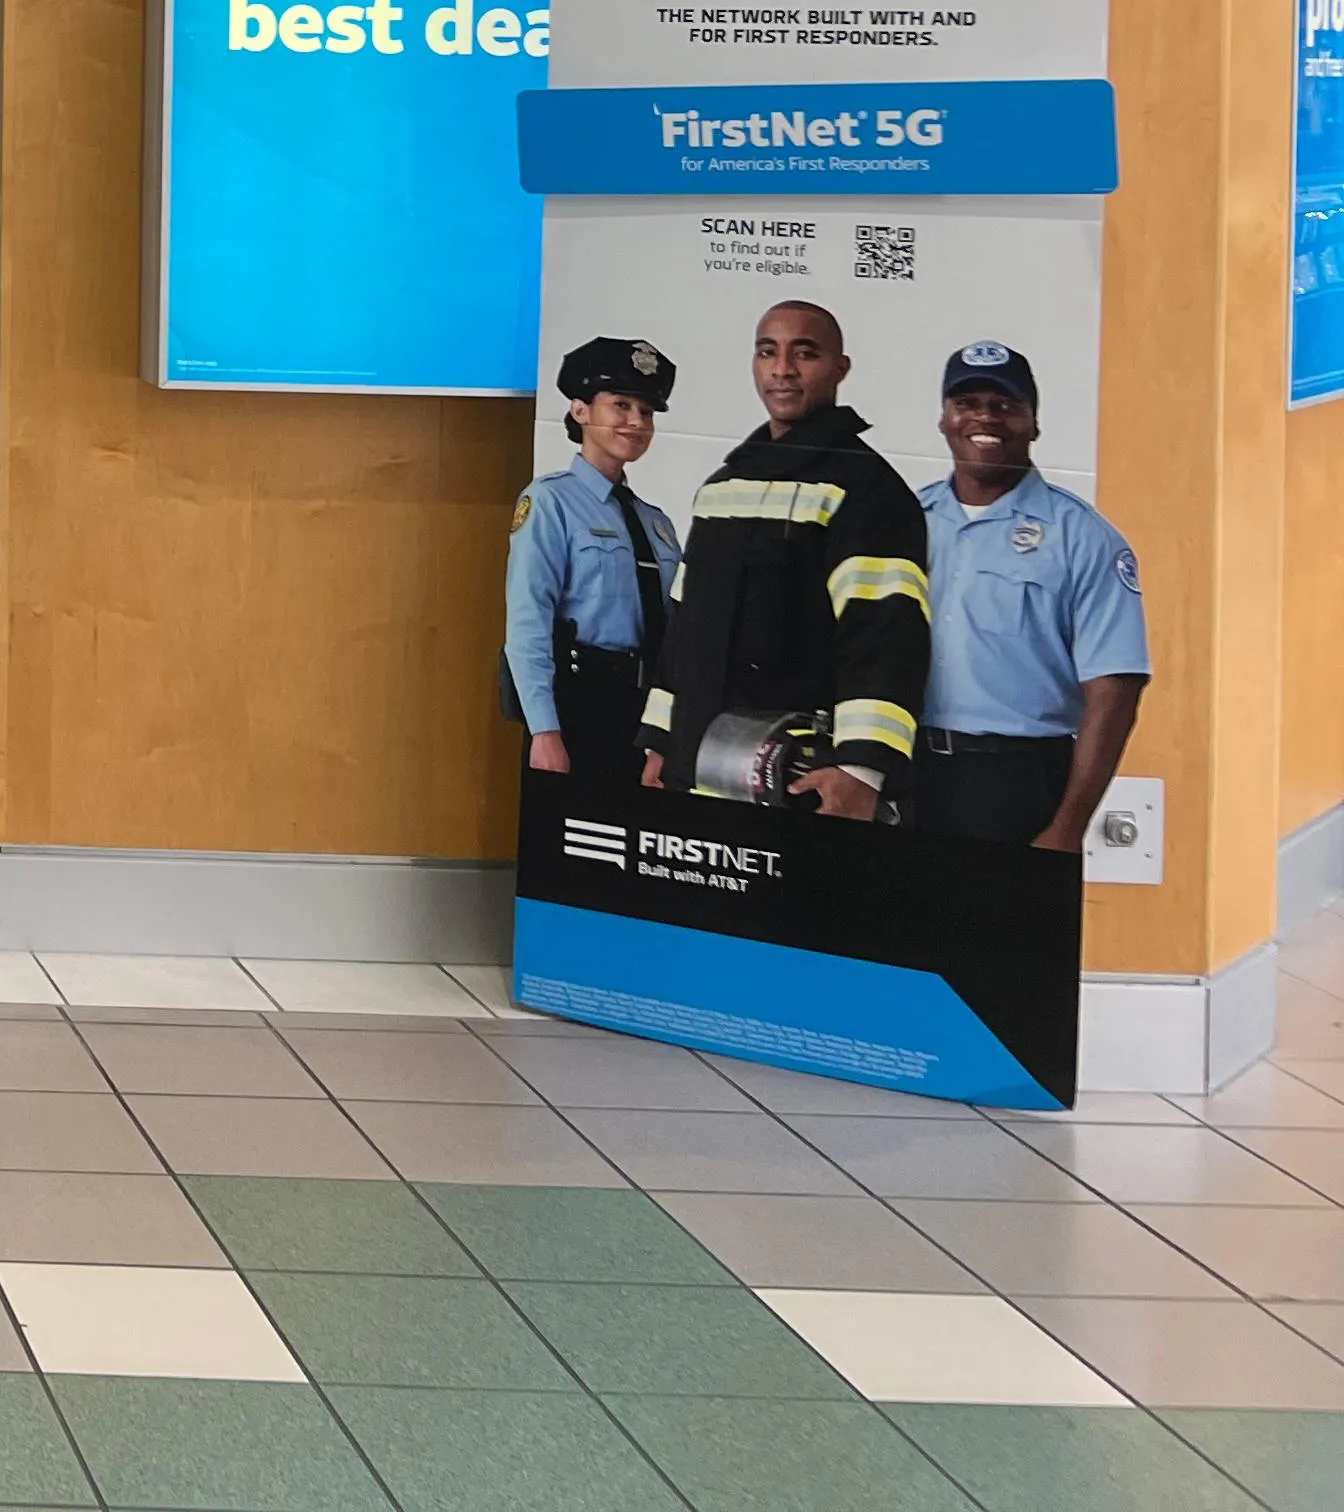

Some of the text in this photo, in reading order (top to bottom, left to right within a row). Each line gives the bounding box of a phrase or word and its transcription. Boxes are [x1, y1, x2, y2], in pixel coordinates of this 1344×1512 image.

[656, 8, 977, 27] THE NETWORK BUILT WITH AND
[689, 28, 939, 46] FOR FIRST RESPONDERS.
[681, 156, 704, 171] for
[788, 156, 825, 171] First
[829, 156, 930, 174] Responders
[701, 218, 816, 239] SCAN HERE
[710, 240, 807, 257] to find out if
[638, 861, 749, 893] Built with AT&T
